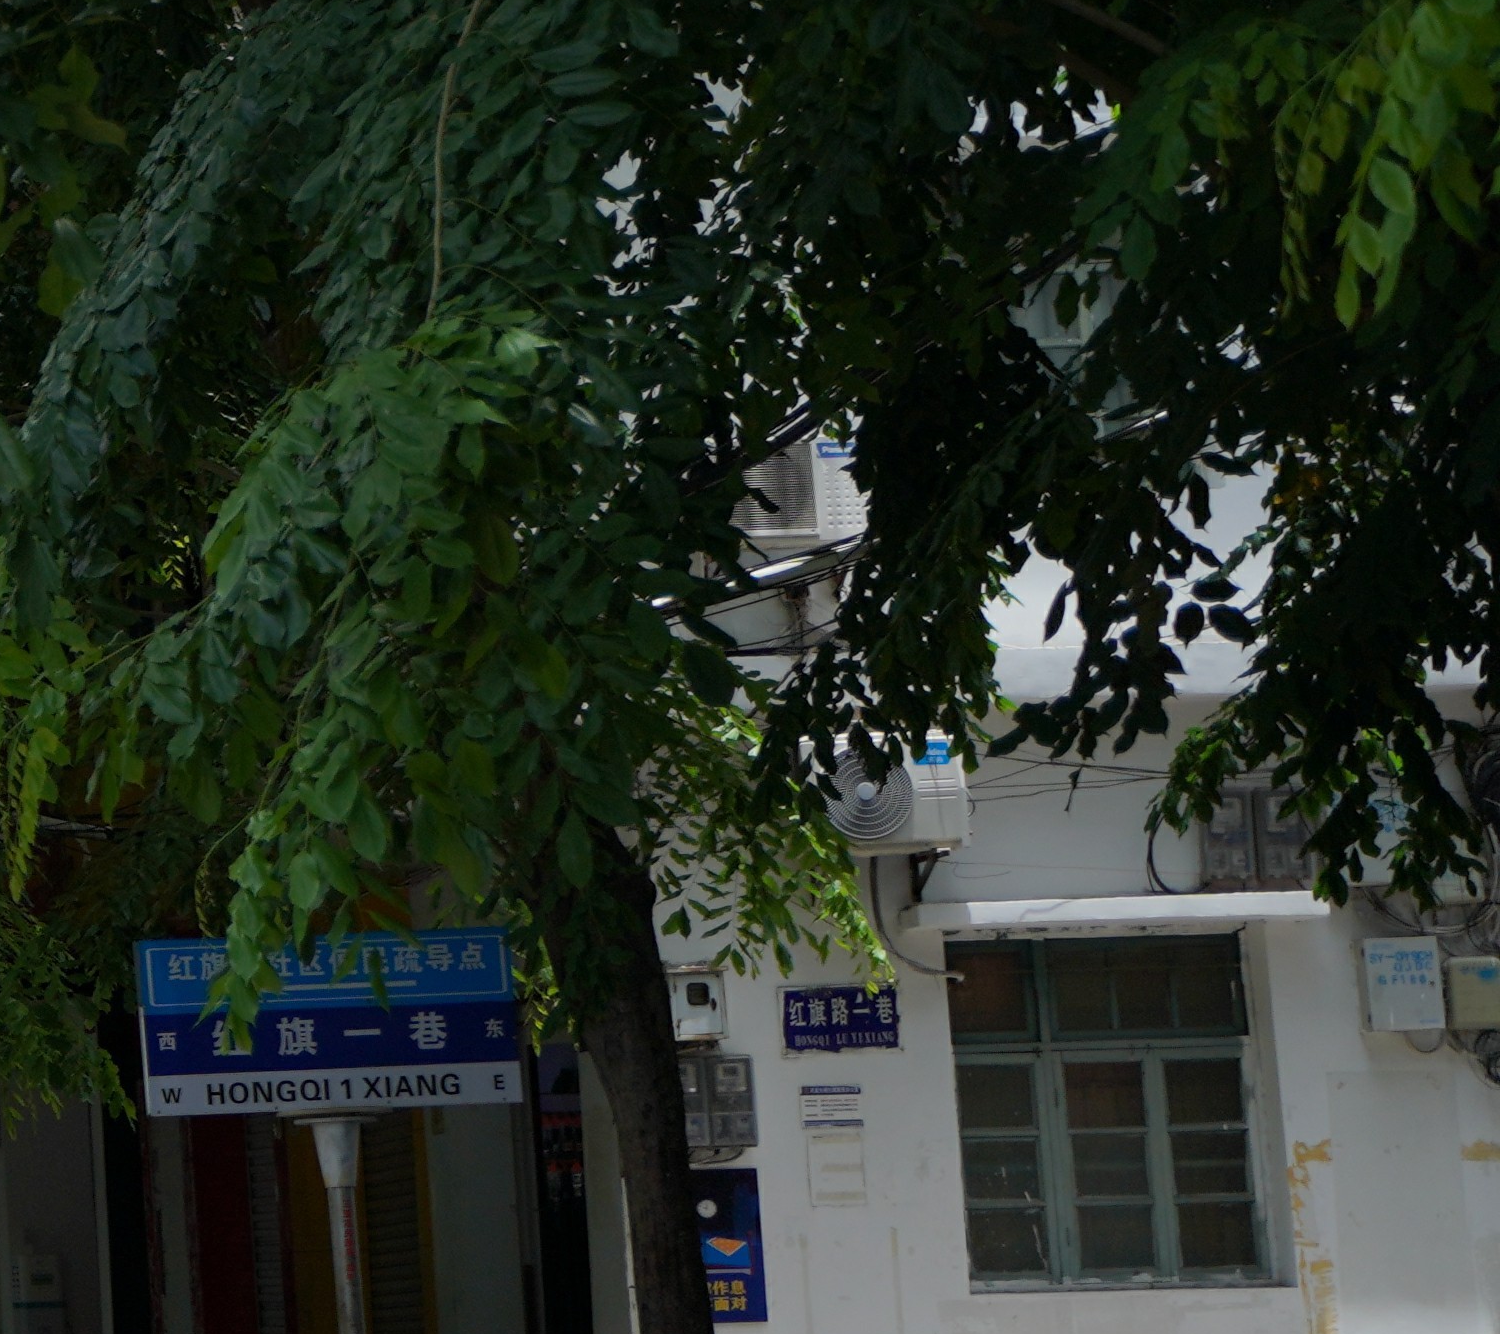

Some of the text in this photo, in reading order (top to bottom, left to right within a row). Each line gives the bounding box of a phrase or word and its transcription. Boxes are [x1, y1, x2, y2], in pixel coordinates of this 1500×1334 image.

[789, 994, 894, 1027] 红旗路一巷
[156, 1011, 505, 1057] 西 红旗一巷 东
[162, 1073, 505, 1105] W HONGQI 1 XIANG E
[707, 1280, 747, 1296] 作息
[709, 1296, 748, 1312] 面对
